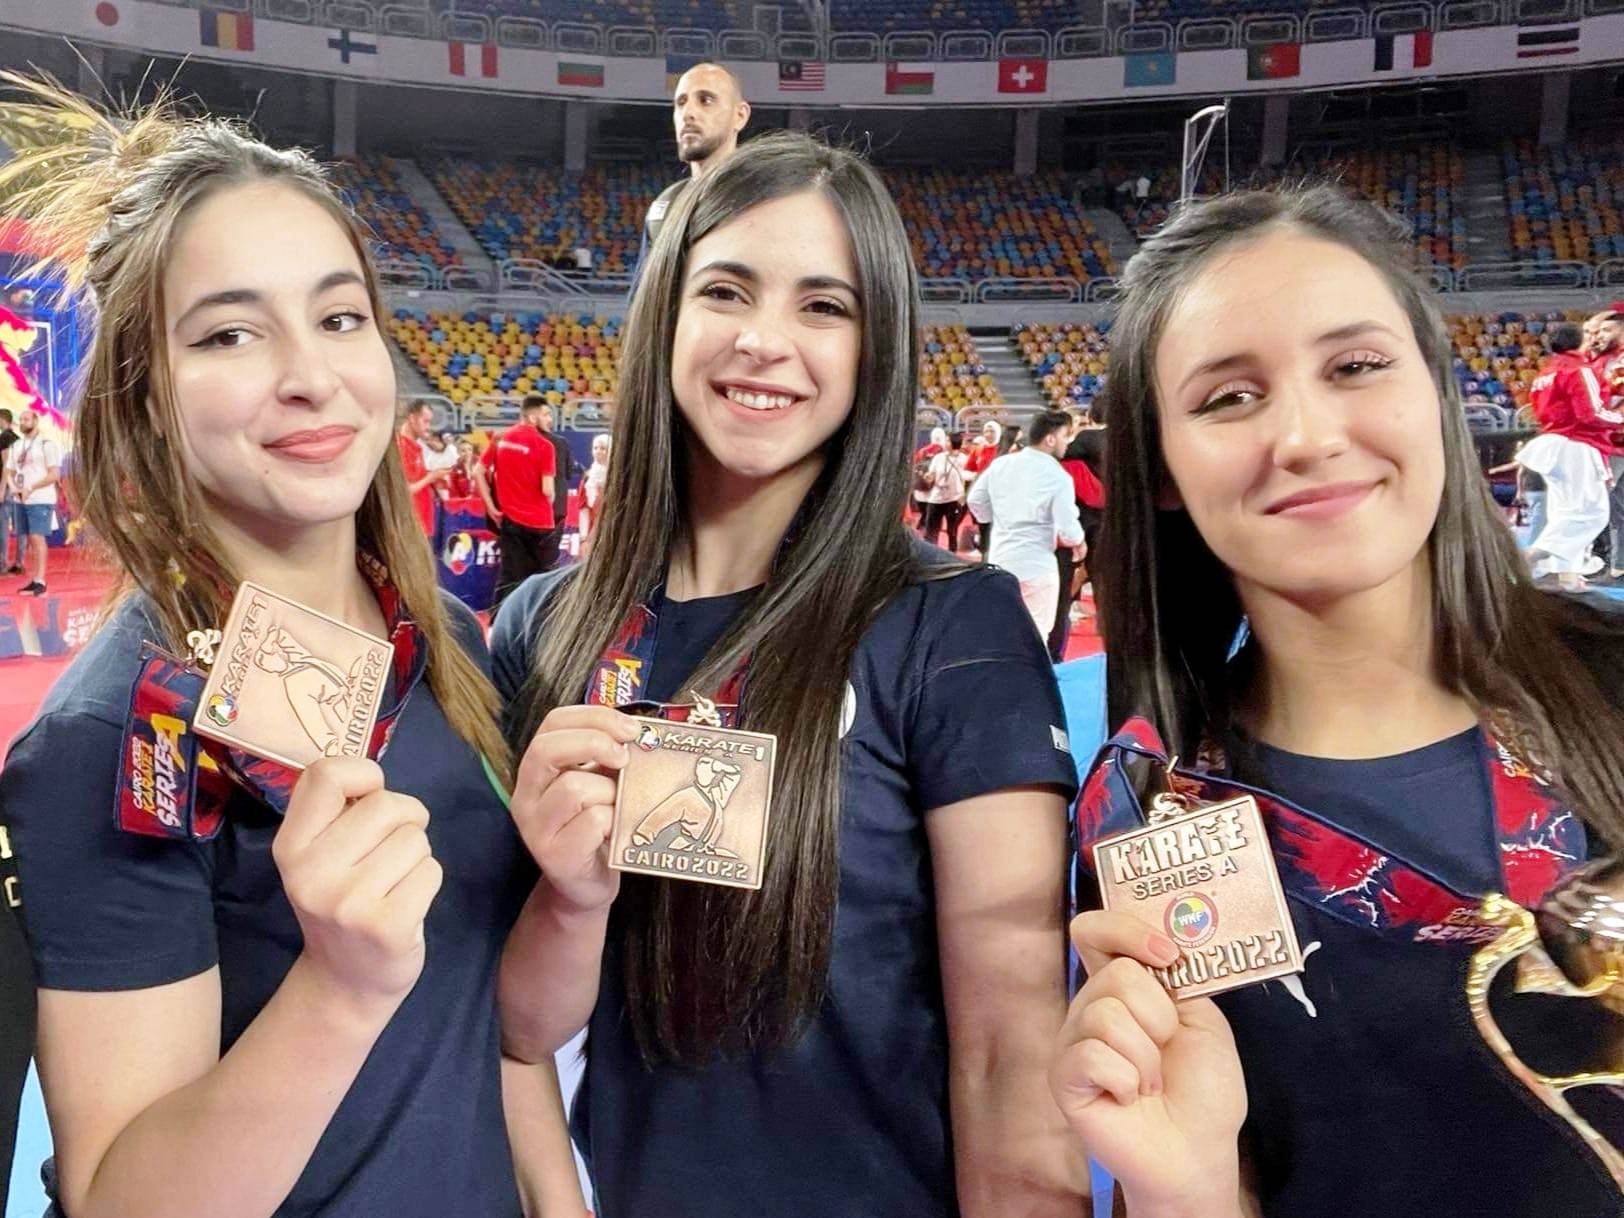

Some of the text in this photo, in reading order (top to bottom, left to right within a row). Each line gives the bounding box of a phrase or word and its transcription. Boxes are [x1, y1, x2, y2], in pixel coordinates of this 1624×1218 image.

[342, 649, 385, 757] AIRO2022
[155, 731, 182, 828] SERIES
[1108, 809, 1248, 884] KARATE
[1132, 856, 1238, 900] SERIES A
[1177, 911, 1204, 927] WKF
